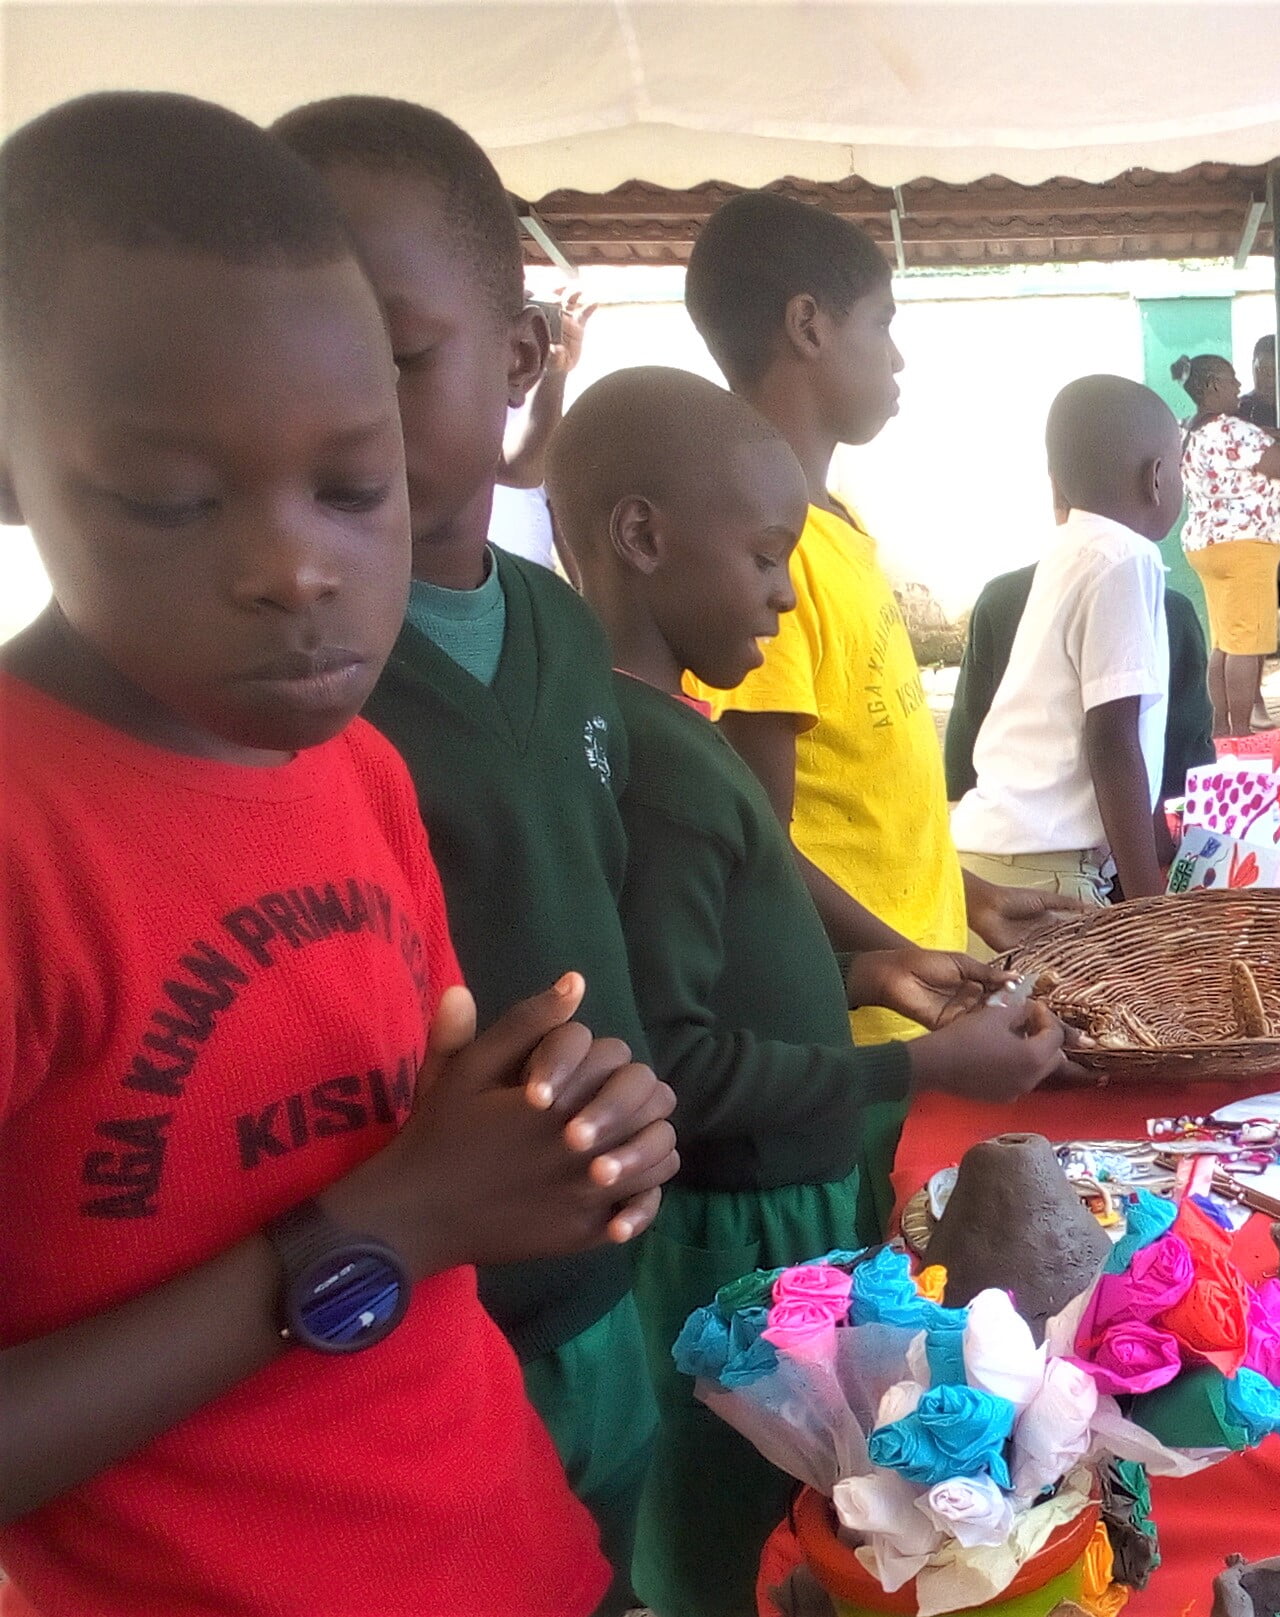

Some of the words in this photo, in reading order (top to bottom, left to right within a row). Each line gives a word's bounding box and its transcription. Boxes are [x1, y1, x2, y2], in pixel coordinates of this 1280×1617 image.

[864, 684, 894, 729] AGA
[119, 939, 251, 1098] KHAN
[77, 1111, 174, 1220] AGA
